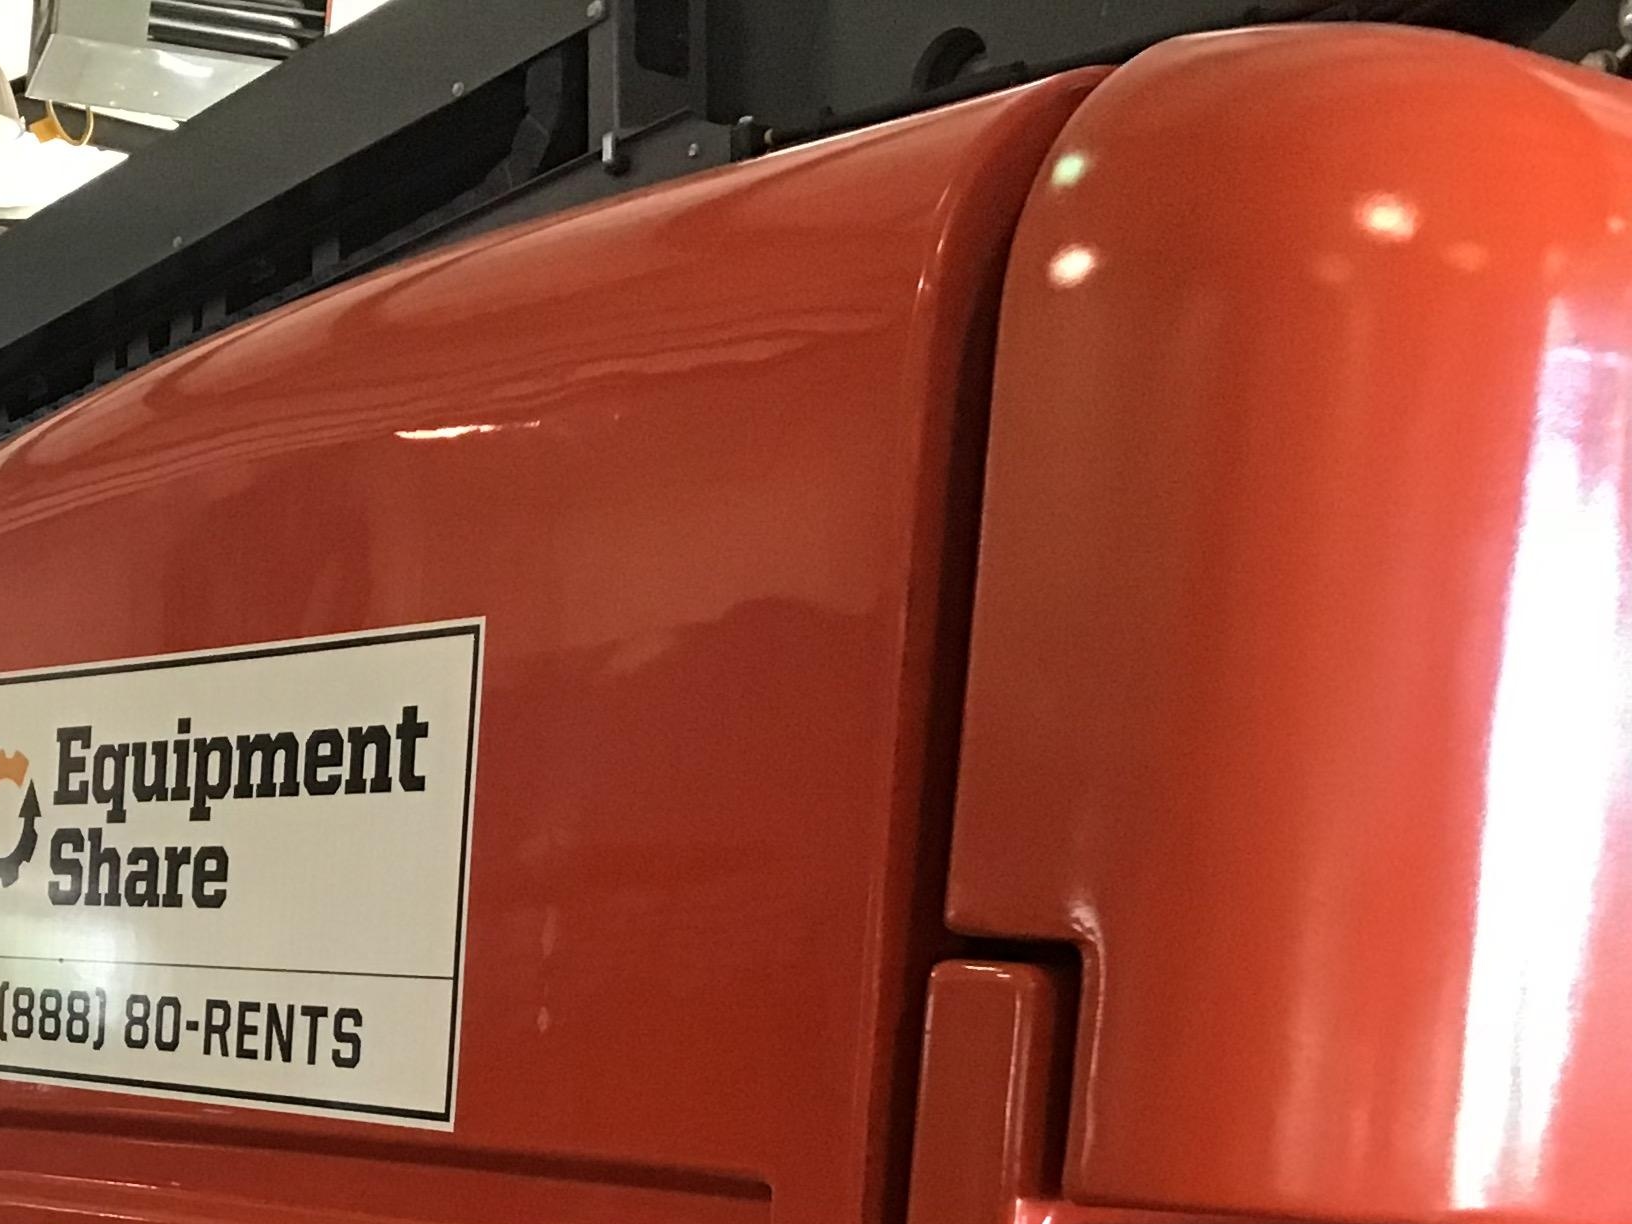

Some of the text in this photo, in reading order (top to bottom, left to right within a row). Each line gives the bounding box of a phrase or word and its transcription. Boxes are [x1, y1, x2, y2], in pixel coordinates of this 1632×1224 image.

[53, 705, 429, 823] Equipment
[47, 827, 229, 909] Share
[124, 994, 364, 1069] 80-RENTS
